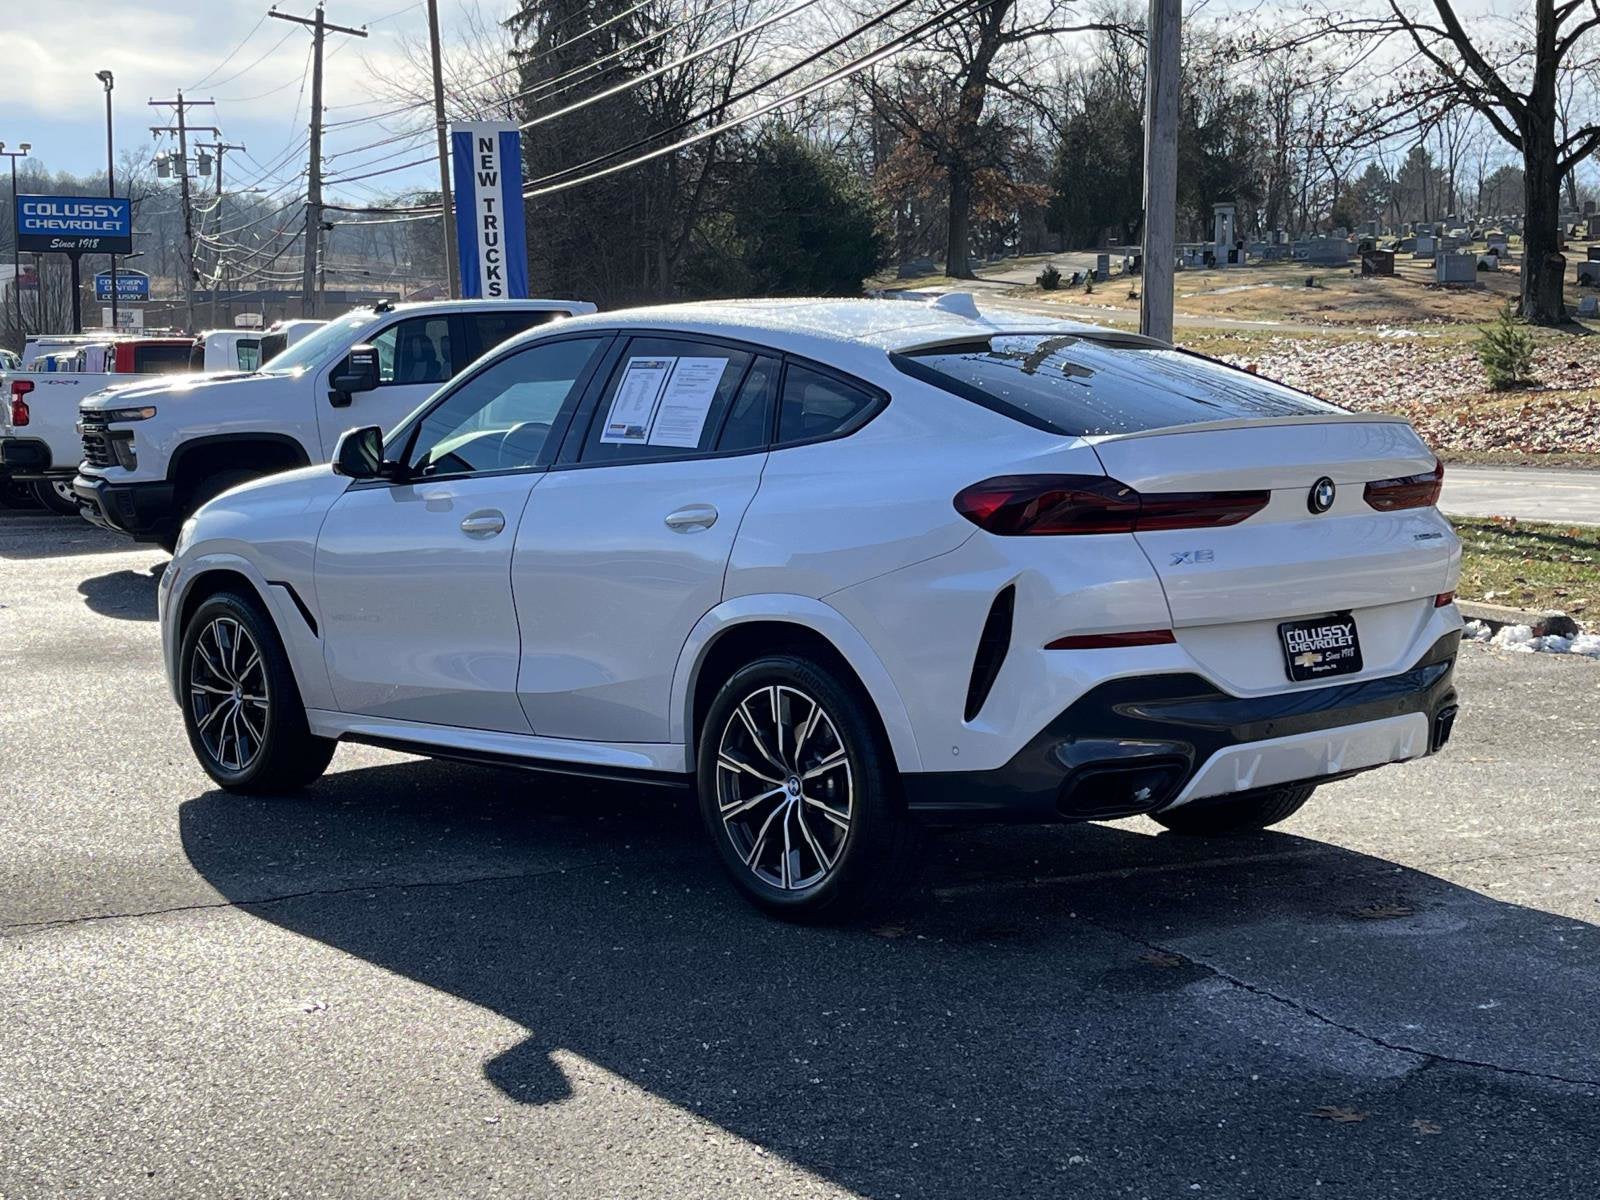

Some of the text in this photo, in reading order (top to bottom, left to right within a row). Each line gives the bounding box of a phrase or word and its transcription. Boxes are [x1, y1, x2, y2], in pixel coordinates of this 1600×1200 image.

[477, 137, 498, 187] NEW
[23, 203, 123, 218] COLUSSY
[25, 218, 123, 231] CHEVROLET
[50, 238, 100, 249] Since 1918
[483, 198, 502, 297] TRUCKS
[1286, 623, 1352, 644] COLUSSY
[1289, 635, 1354, 653] CHEVROLET
